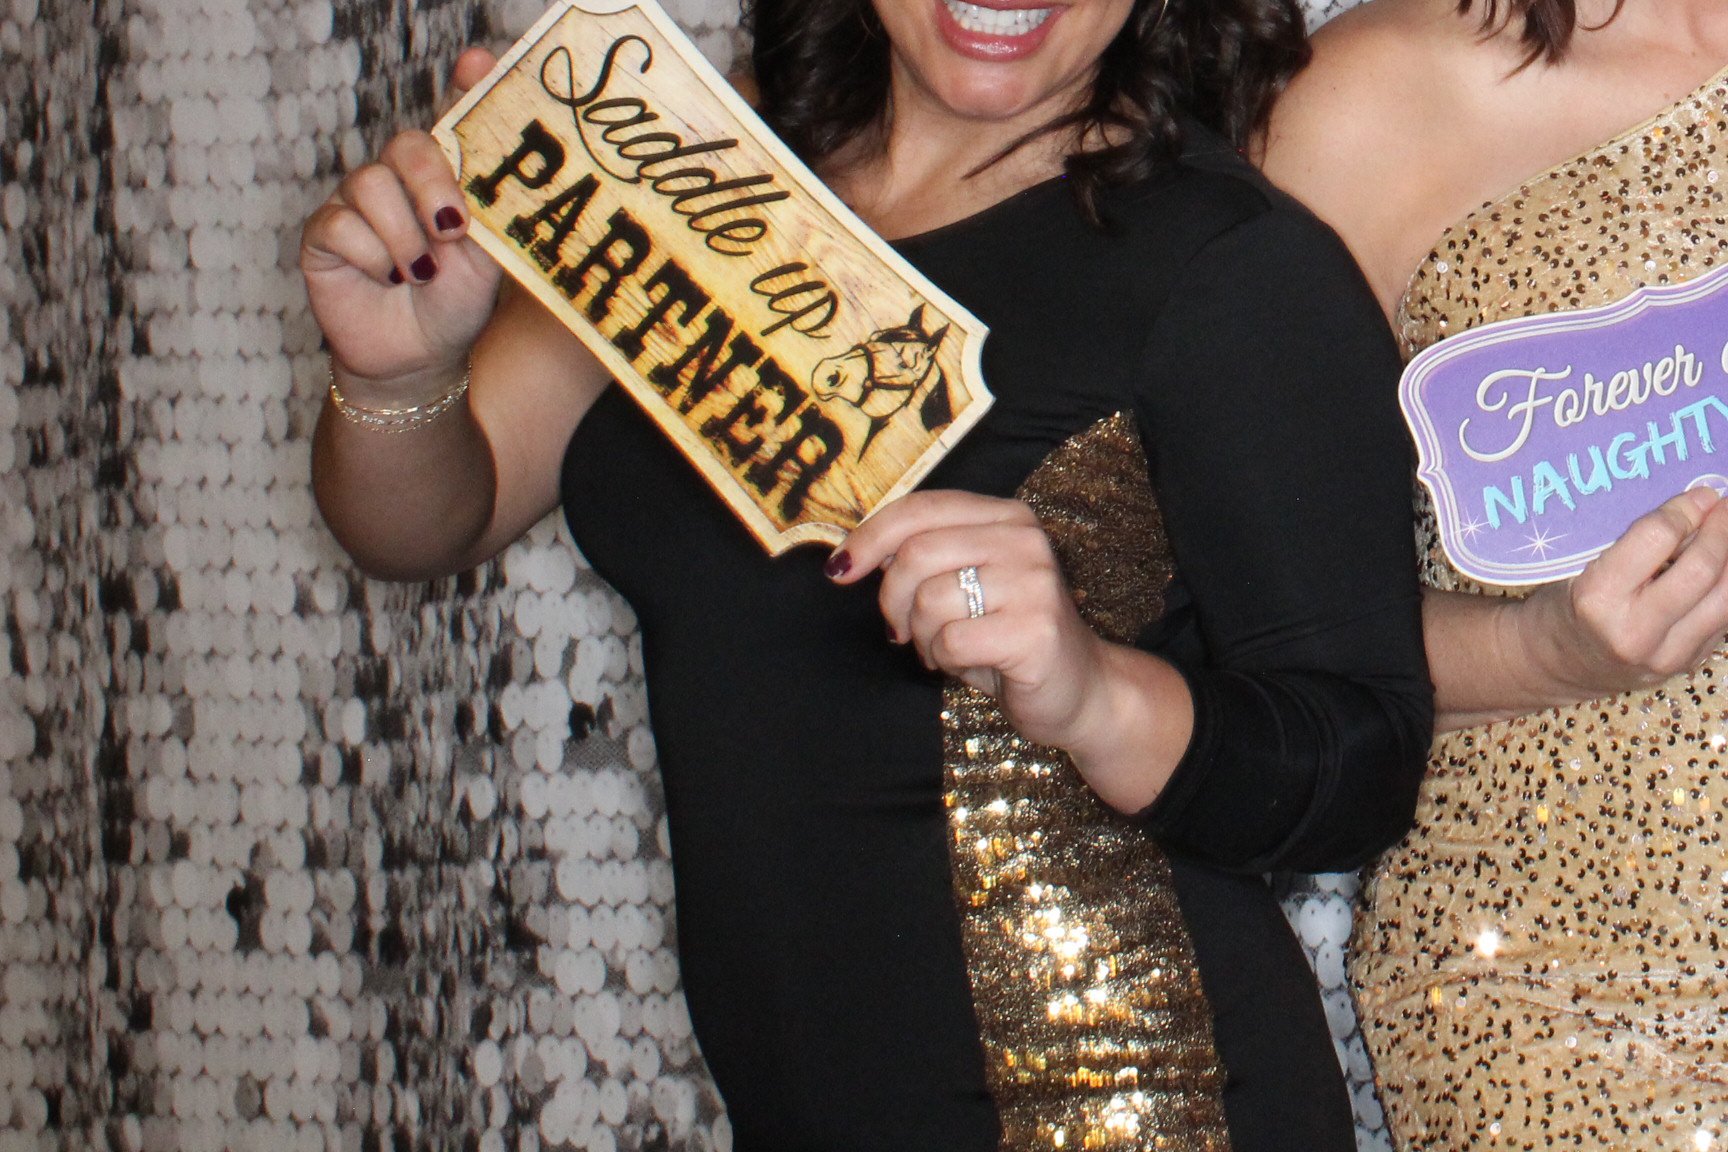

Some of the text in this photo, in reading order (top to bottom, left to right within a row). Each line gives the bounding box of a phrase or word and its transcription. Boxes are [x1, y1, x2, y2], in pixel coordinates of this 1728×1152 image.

[464, 118, 845, 522] PARTNER
[540, 35, 839, 340] Saddle up
[1459, 344, 1702, 462] Forever
